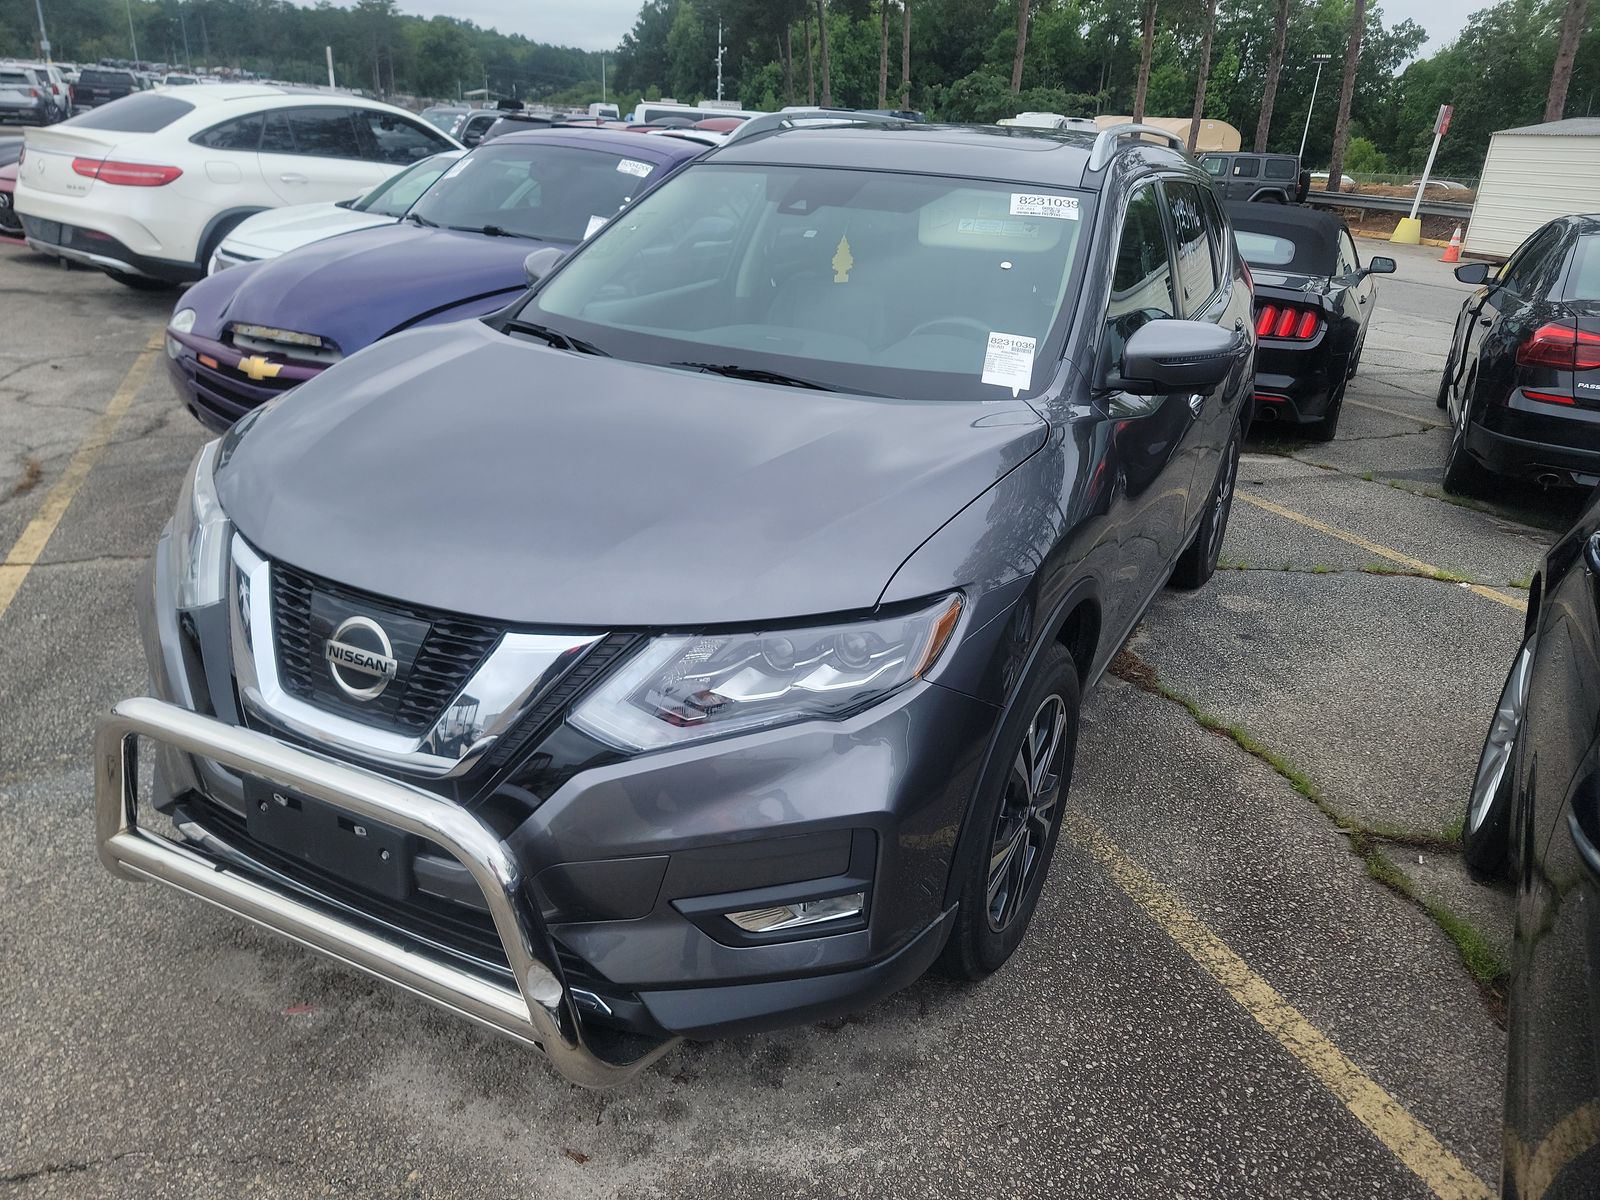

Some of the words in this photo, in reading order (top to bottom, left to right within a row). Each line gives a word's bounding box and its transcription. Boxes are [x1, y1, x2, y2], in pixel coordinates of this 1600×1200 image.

[1019, 196, 1080, 209] 8231039
[990, 337, 1035, 350] 8231039
[328, 644, 388, 673] NISSAN
